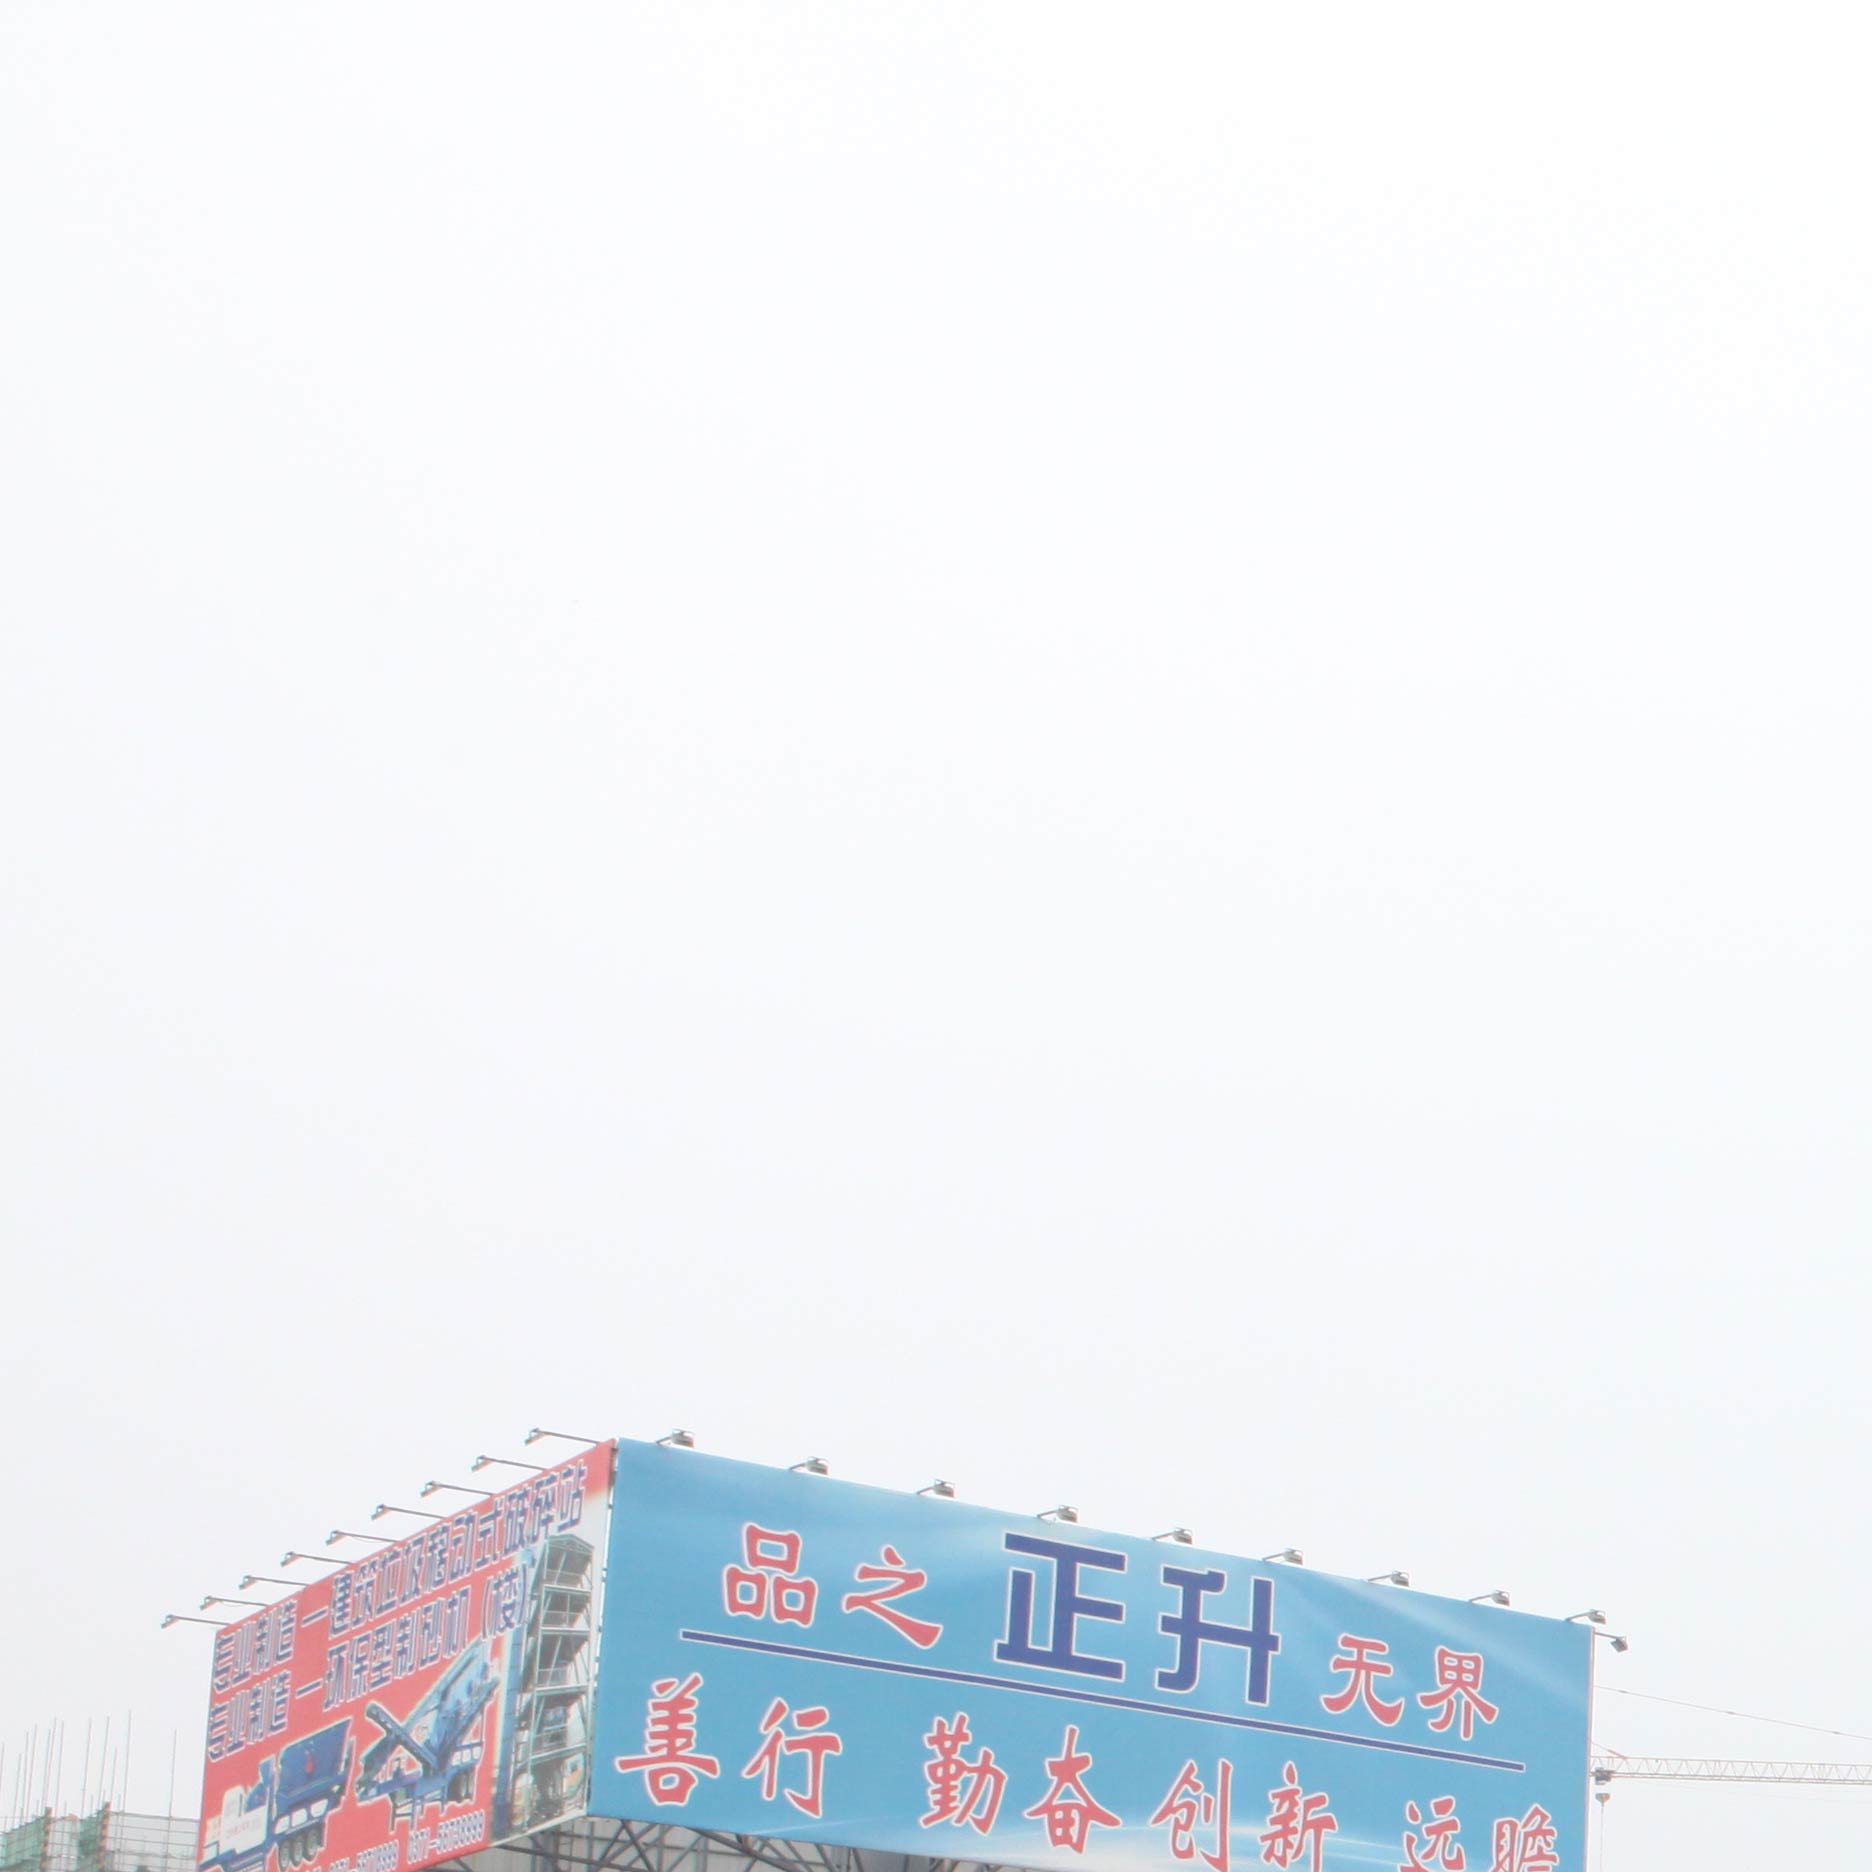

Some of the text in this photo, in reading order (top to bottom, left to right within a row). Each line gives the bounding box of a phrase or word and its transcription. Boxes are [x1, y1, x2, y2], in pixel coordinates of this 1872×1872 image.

[721, 1521, 1499, 1741] 品之 正升 无界
[614, 1672, 844, 1819] 善行
[919, 1711, 1122, 1856] 勤奋
